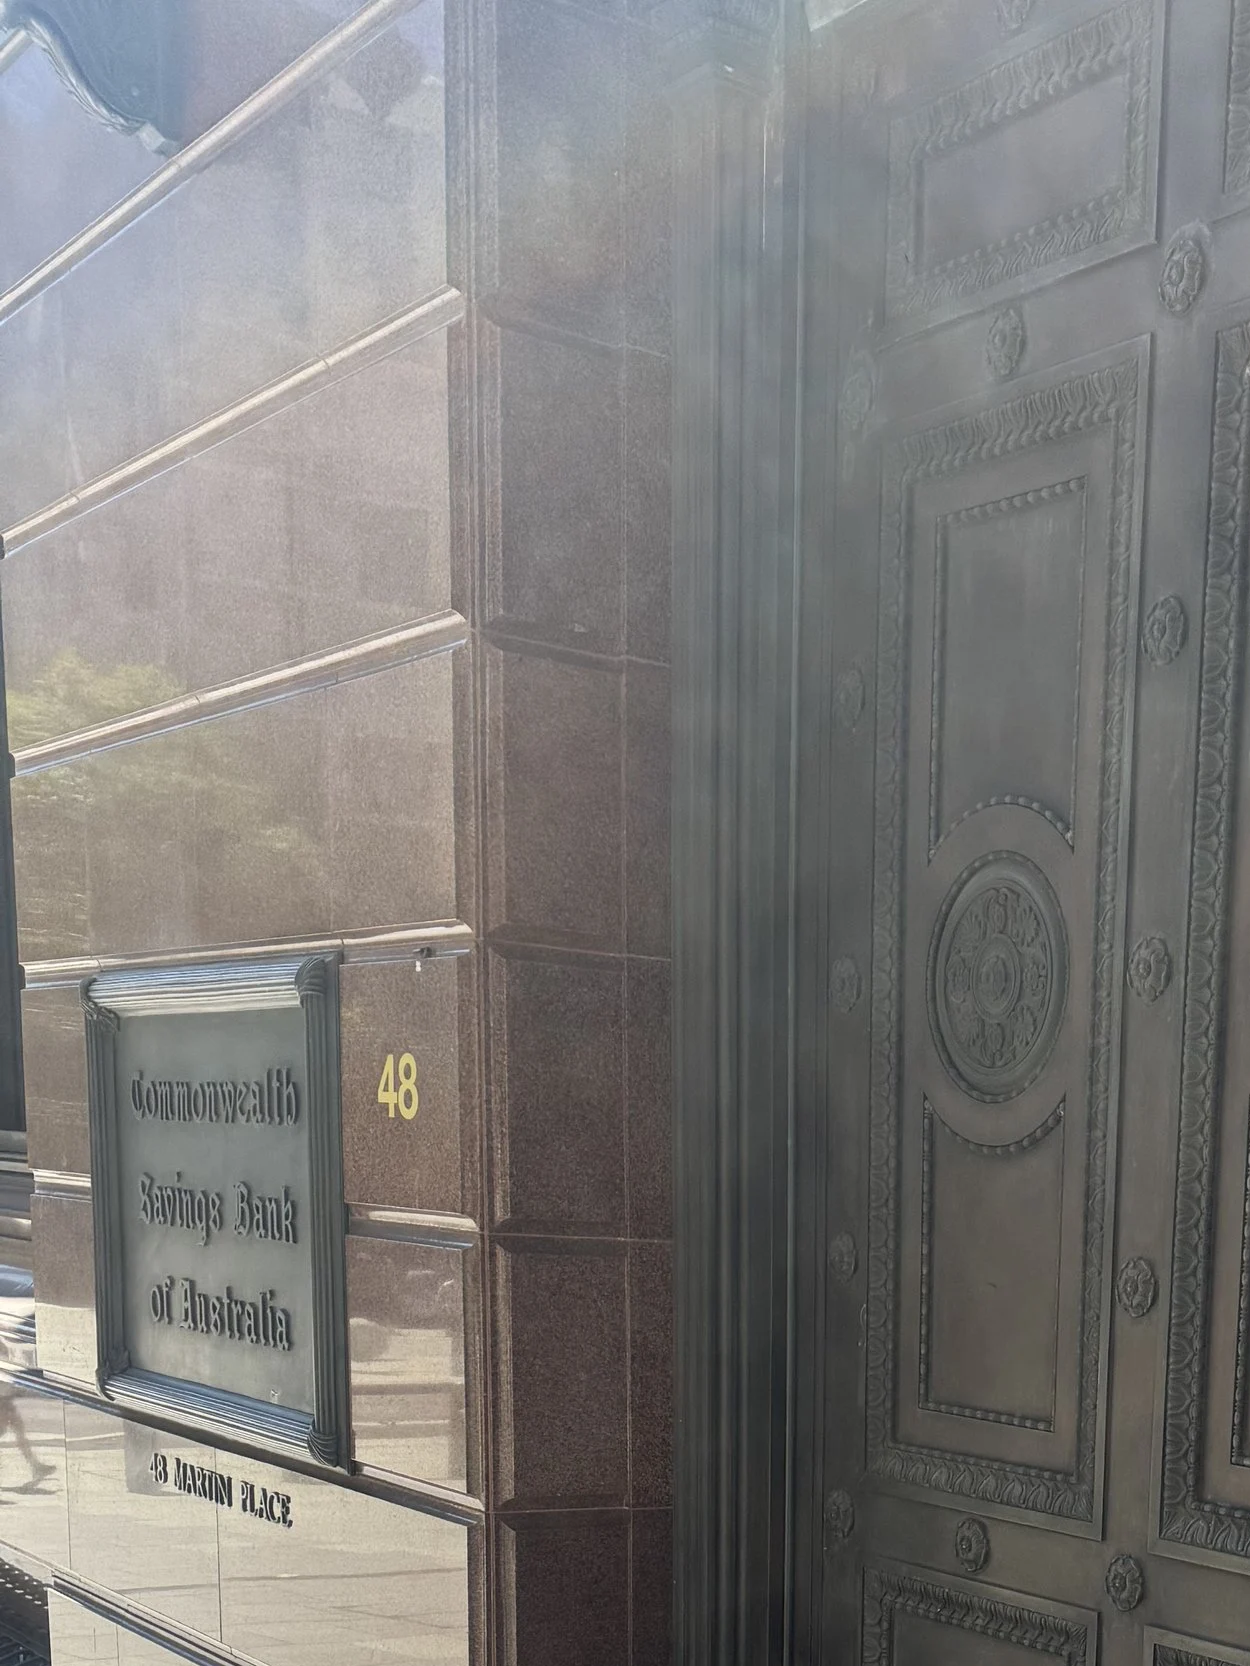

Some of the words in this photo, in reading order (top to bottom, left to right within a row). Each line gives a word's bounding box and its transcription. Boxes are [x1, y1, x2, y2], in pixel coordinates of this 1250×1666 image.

[131, 1067, 299, 1127] Commonwealth
[377, 1052, 419, 1120] 48
[138, 1171, 222, 1247] Savings
[233, 1181, 298, 1244] Bank
[151, 1275, 174, 1325] of
[179, 1277, 294, 1351] Australia
[149, 1453, 168, 1484] 48
[174, 1457, 232, 1507] MARTIN
[239, 1480, 293, 1528] PLACE
